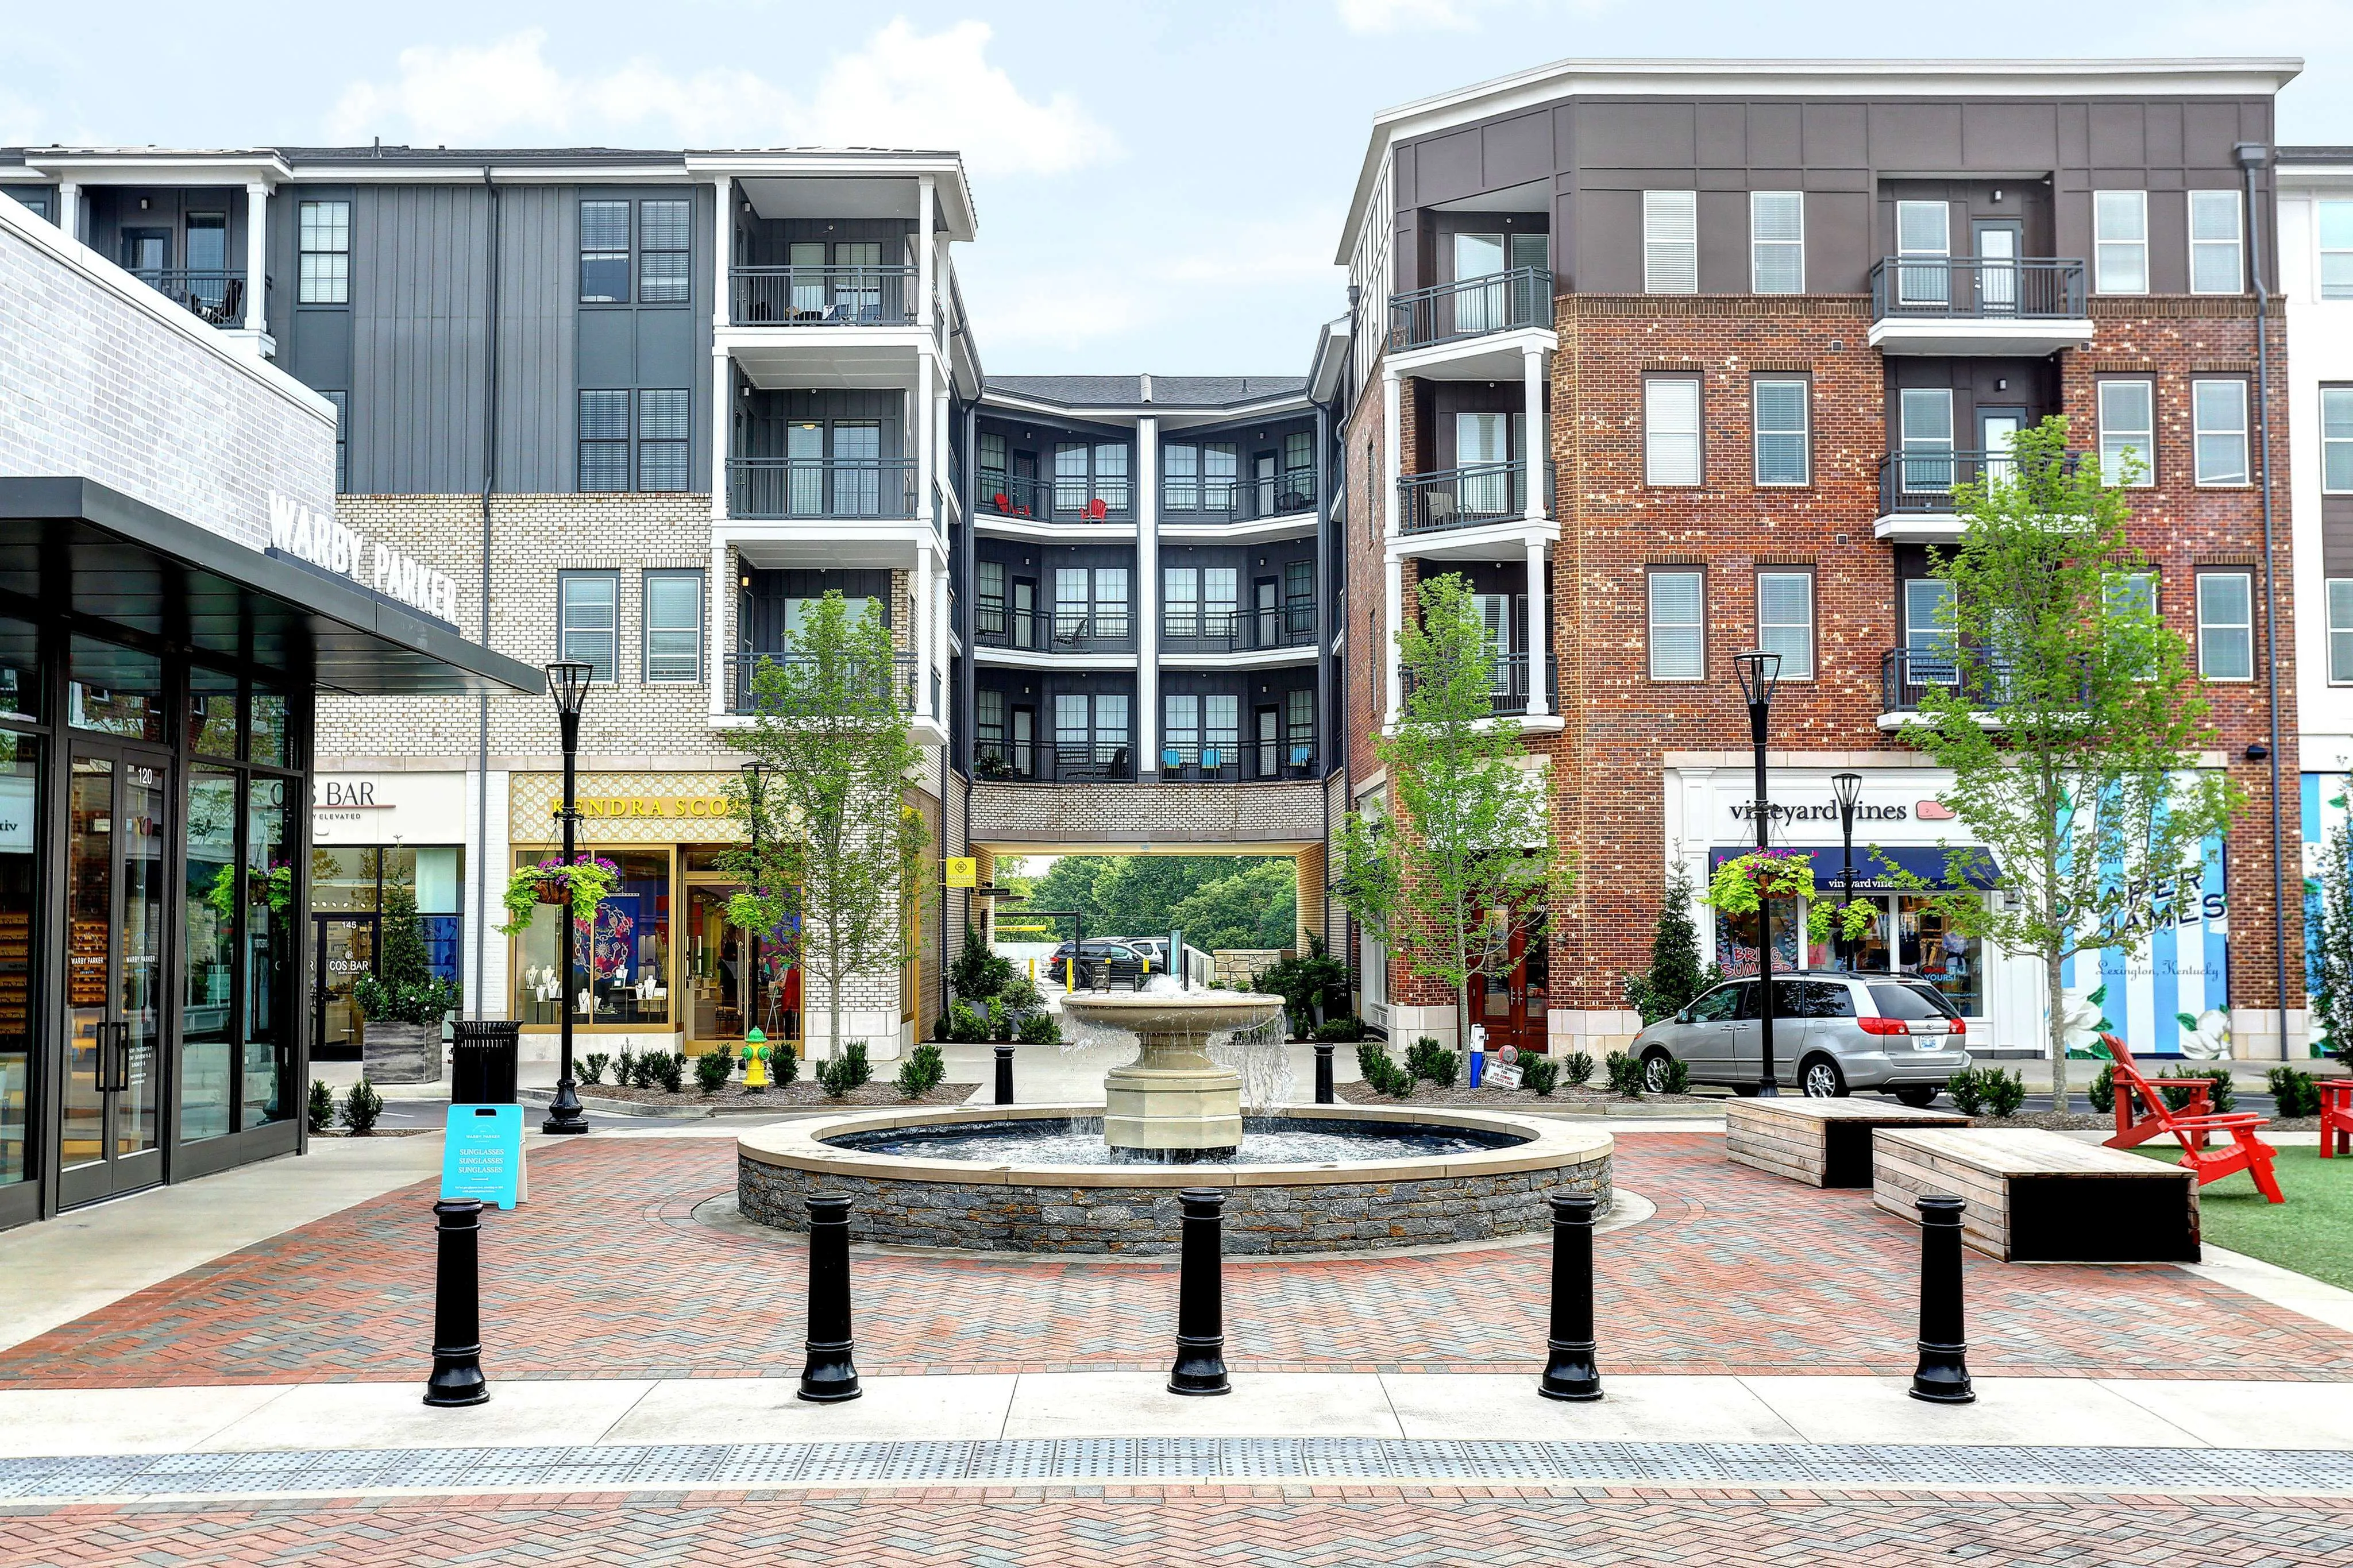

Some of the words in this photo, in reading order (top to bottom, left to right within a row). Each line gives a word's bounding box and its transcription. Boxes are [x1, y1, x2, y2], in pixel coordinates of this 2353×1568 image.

[268, 489, 364, 579] WARBY
[375, 542, 457, 623] PARKER
[138, 767, 152, 785] 120
[327, 782, 375, 805] BAR
[675, 799, 739, 816] SCO
[1729, 800, 1839, 826] vieyard
[342, 921, 357, 929] 145
[71, 957, 86, 965] WARBY
[87, 956, 104, 964] PARKER
[126, 955, 140, 963] WARBY
[141, 955, 155, 963] PARKER
[1734, 947, 1781, 962] BRIG
[329, 960, 348, 971] COS
[350, 960, 368, 971] BAR
[2096, 960, 2159, 981] Lexington,
[2162, 960, 2219, 982] Kentucky
